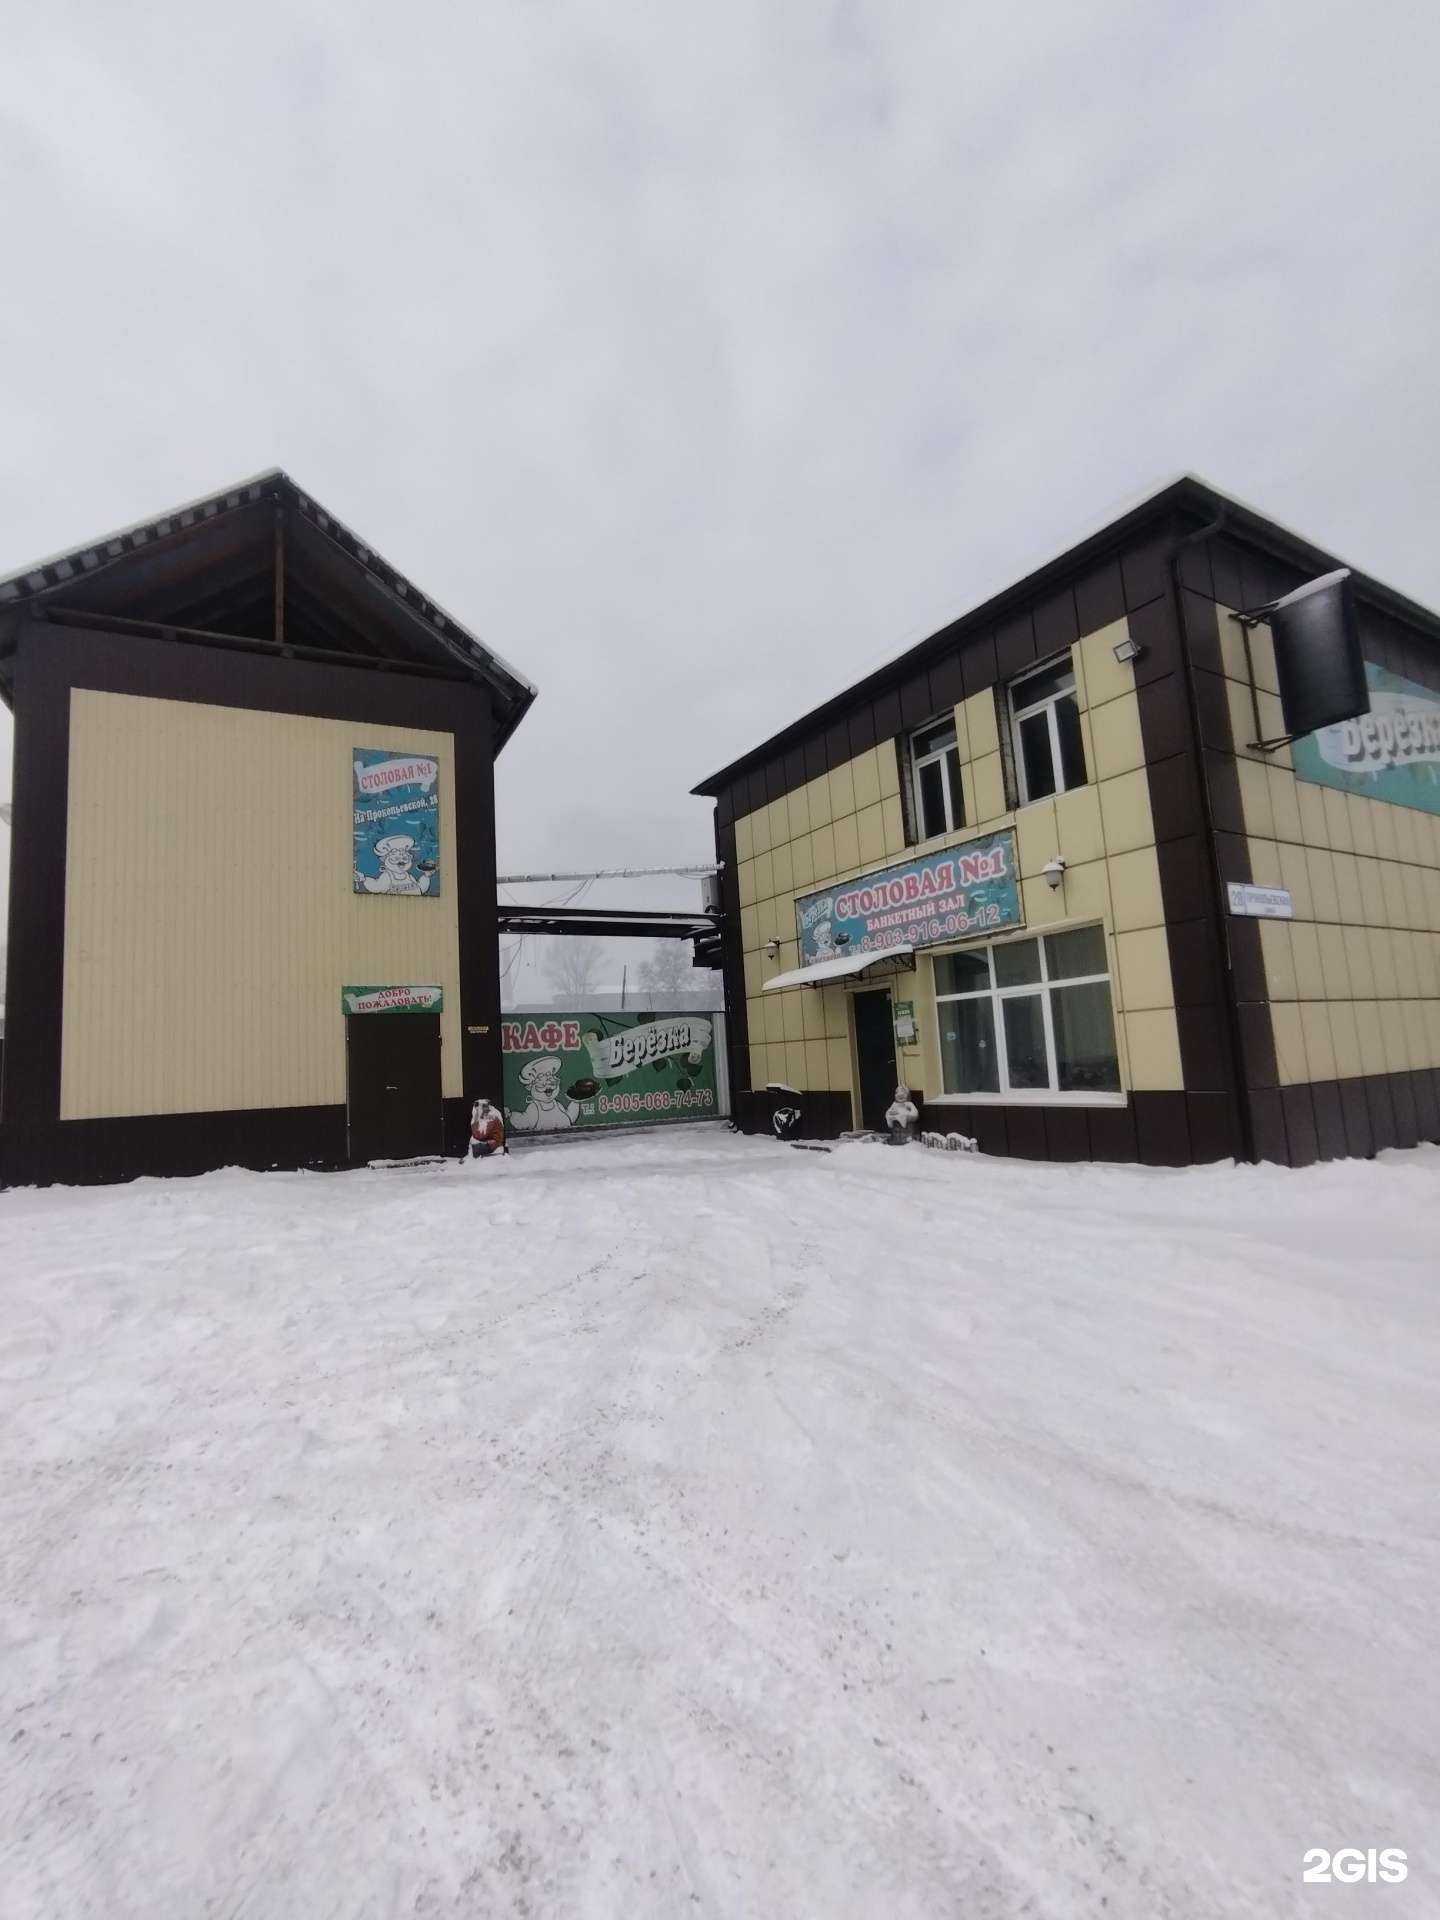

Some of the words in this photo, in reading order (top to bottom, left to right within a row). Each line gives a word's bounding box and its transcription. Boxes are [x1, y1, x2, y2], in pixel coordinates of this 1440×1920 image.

[361, 766, 414, 789] СТОЛОВАЯ
[416, 762, 432, 777] №1
[354, 812, 365, 824] На
[836, 862, 955, 920] СТОЛОВАЯ
[960, 849, 1006, 886] №1
[866, 901, 936, 931] БАНКЕТНЫЙ
[938, 894, 965, 913] ЗАЛ
[358, 994, 432, 1010] ПОЖАЛОВАТЬ!
[378, 988, 411, 1000] ДОБРО
[501, 1021, 580, 1052] КАФЕ
[608, 1023, 692, 1068] Берёзка
[599, 1088, 713, 1114] 8-905-068-74-73
